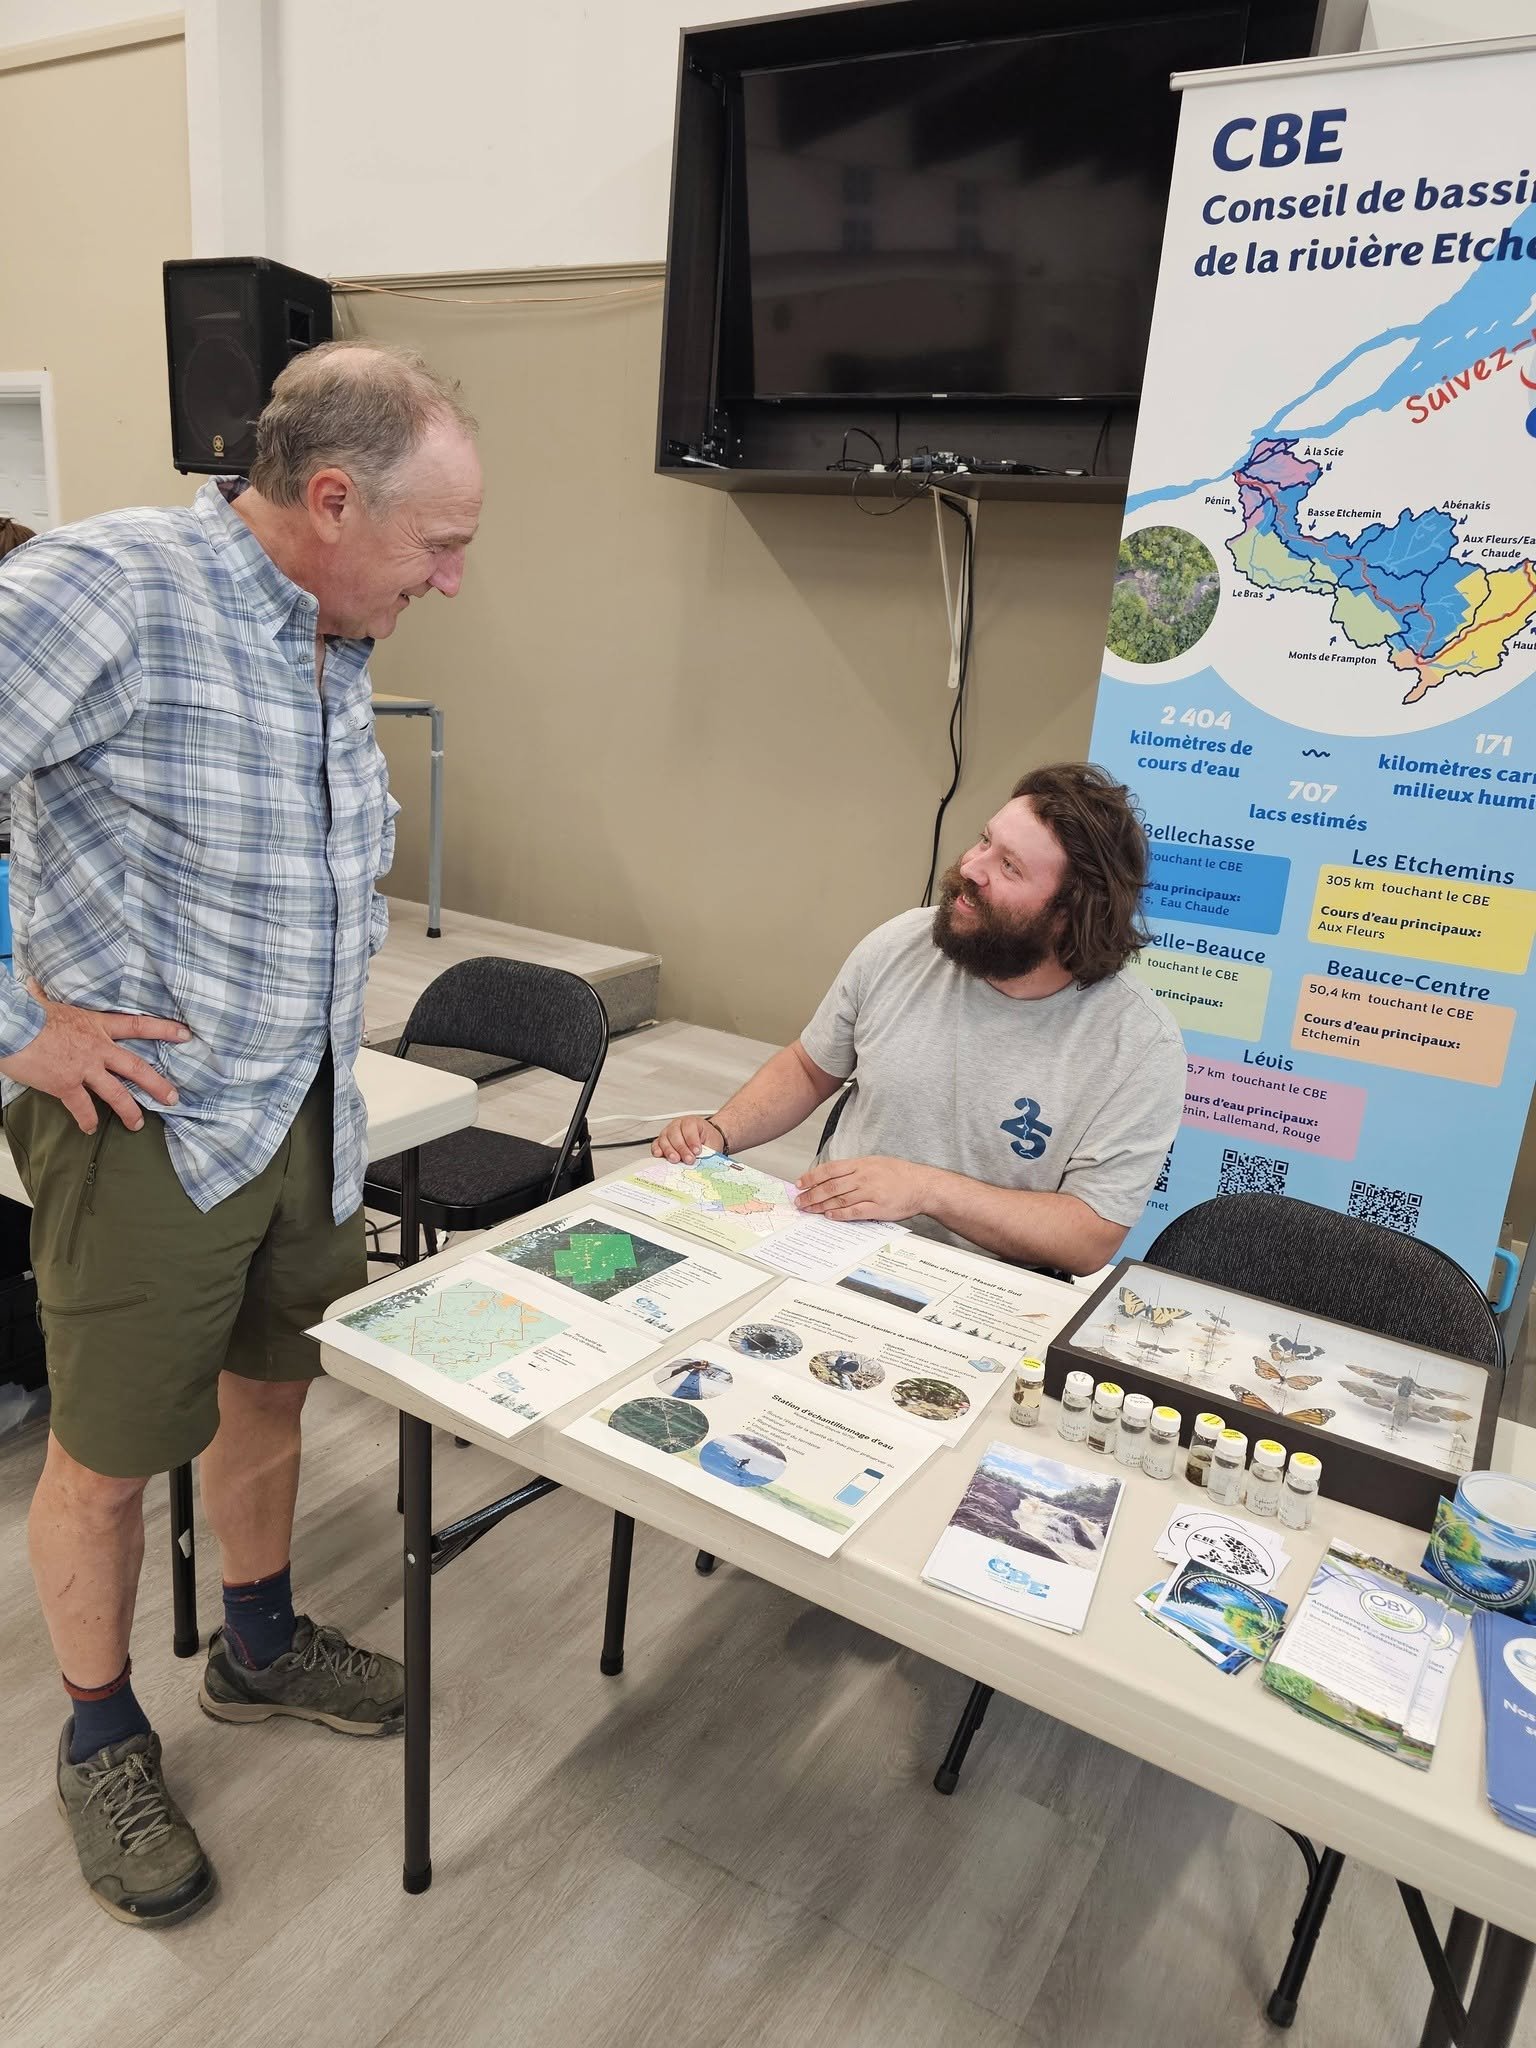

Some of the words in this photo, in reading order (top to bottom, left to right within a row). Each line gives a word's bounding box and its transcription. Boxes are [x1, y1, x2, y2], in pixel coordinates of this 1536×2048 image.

[1212, 108, 1347, 172] CBE
[1202, 183, 1348, 225] Conseil
[1356, 180, 1406, 215] de
[1194, 245, 1238, 277] de
[1245, 242, 1279, 274] la
[1288, 233, 1424, 272] rivière
[1406, 328, 1536, 424] Suivez-
[1304, 445, 1311, 456] À
[1313, 447, 1321, 456] la
[1324, 447, 1344, 457] Scie
[1205, 496, 1230, 506] Pénin
[1442, 500, 1491, 510] Abénakis
[1307, 508, 1335, 518] Basse
[1337, 508, 1382, 519] Etchemin
[1463, 534, 1484, 543] Aux
[1481, 548, 1521, 558] Chaude
[1232, 589, 1243, 598] Le
[1244, 589, 1263, 599] Bras
[1288, 651, 1317, 661] Monts
[1318, 653, 1330, 662] de
[1331, 654, 1377, 666] Frampton
[1130, 730, 1226, 753] kilomètres
[1230, 740, 1253, 756] de
[1475, 733, 1513, 757] 171
[1138, 757, 1187, 773] cours
[1191, 759, 1240, 778] d'eau
[1378, 754, 1492, 780] kilomètres
[1288, 780, 1338, 803] 707
[1393, 782, 1474, 804] milieux
[1249, 803, 1287, 822] lacs
[1291, 811, 1367, 831] estimés
[1143, 823, 1255, 852] Bellechasse
[1205, 857, 1216, 869] le
[1219, 860, 1244, 873] CBE
[1352, 849, 1389, 868] Les
[1394, 854, 1515, 885] Etchemins
[1171, 885, 1241, 902] principaux:
[1326, 875, 1351, 887] 305
[1354, 878, 1375, 891] km
[1381, 882, 1443, 900] touchant
[1446, 890, 1459, 902] le
[1462, 893, 1491, 907] CBE
[1160, 896, 1182, 909] Eau
[1185, 900, 1230, 916] Chaude
[1317, 921, 1343, 933] Aux
[1345, 924, 1385, 940] Fleurs
[1320, 905, 1360, 920] Cours
[1362, 911, 1398, 926] d'eau
[1400, 917, 1482, 938] principaux:
[1147, 958, 1199, 974] touchant
[1202, 966, 1212, 977] le
[1215, 969, 1239, 982] CBE
[1327, 960, 1490, 1001] Beauce-Centre
[1155, 988, 1224, 1008] principaux:
[1309, 983, 1339, 998] 50,4
[1341, 989, 1361, 1001] km
[1368, 993, 1428, 1013] touchant
[1431, 1004, 1444, 1015] le
[1447, 1007, 1474, 1021] CBE
[1301, 1027, 1361, 1047] Etchemin
[1304, 1013, 1342, 1028] Cours
[1344, 1020, 1379, 1035] d'eau
[1381, 1028, 1461, 1050] principaux:
[1243, 1049, 1294, 1072] Lévis
[1207, 1067, 1226, 1080] km
[1231, 1073, 1286, 1092] touchant
[1289, 1083, 1300, 1094] le
[1302, 1087, 1328, 1100] CBE
[1212, 1098, 1245, 1112] d'eau
[1246, 1105, 1319, 1127] principaux:
[1213, 1111, 1279, 1134] Lallemand,
[1282, 1126, 1321, 1143] Rouge
[1007, 1289, 1022, 1297] Sud
[771, 1394, 801, 1411] Station
[800, 1408, 871, 1441] d'échantillonnage
[871, 1437, 895, 1452] d'eau
[1311, 1600, 1370, 1630] Aménagement
[1370, 1595, 1414, 1615] OBV
